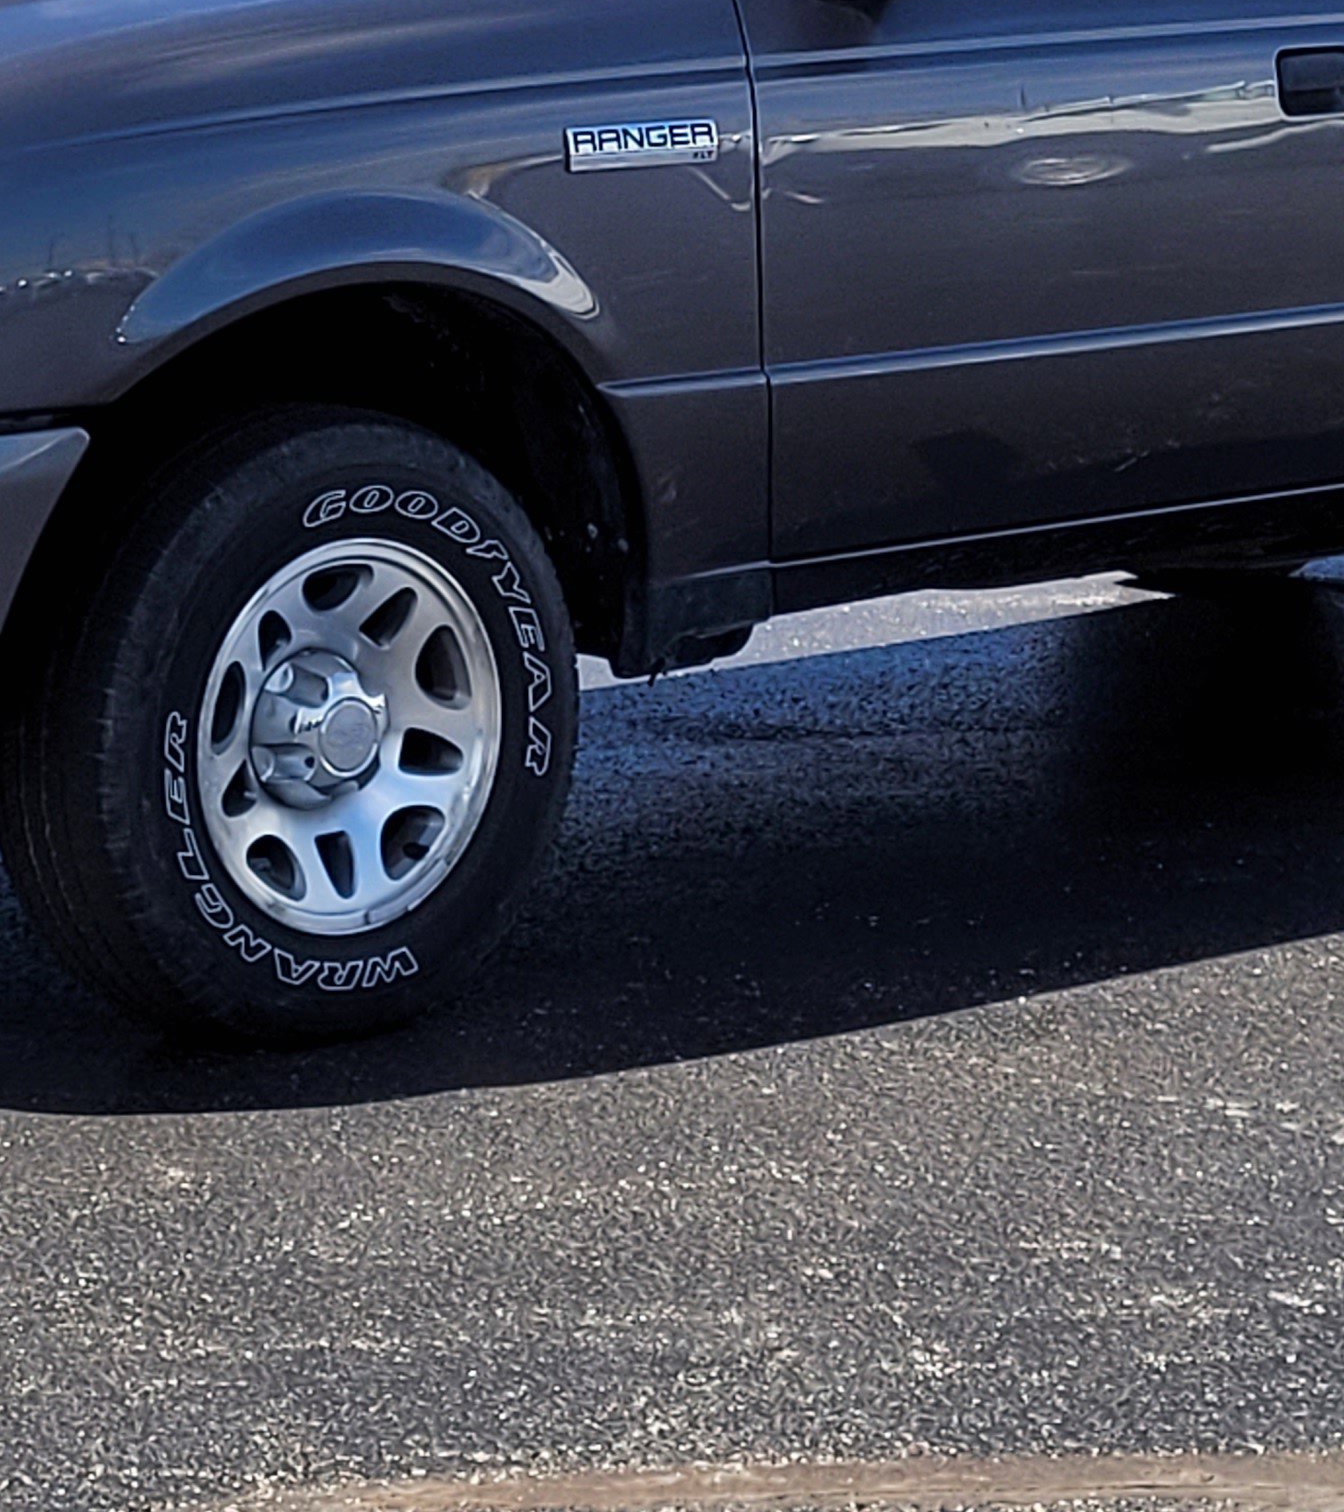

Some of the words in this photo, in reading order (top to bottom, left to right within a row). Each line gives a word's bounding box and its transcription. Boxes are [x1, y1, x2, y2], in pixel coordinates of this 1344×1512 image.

[572, 123, 714, 154] RANGER
[303, 485, 552, 776] GOODYEAR
[164, 711, 419, 991] WRANGLER
